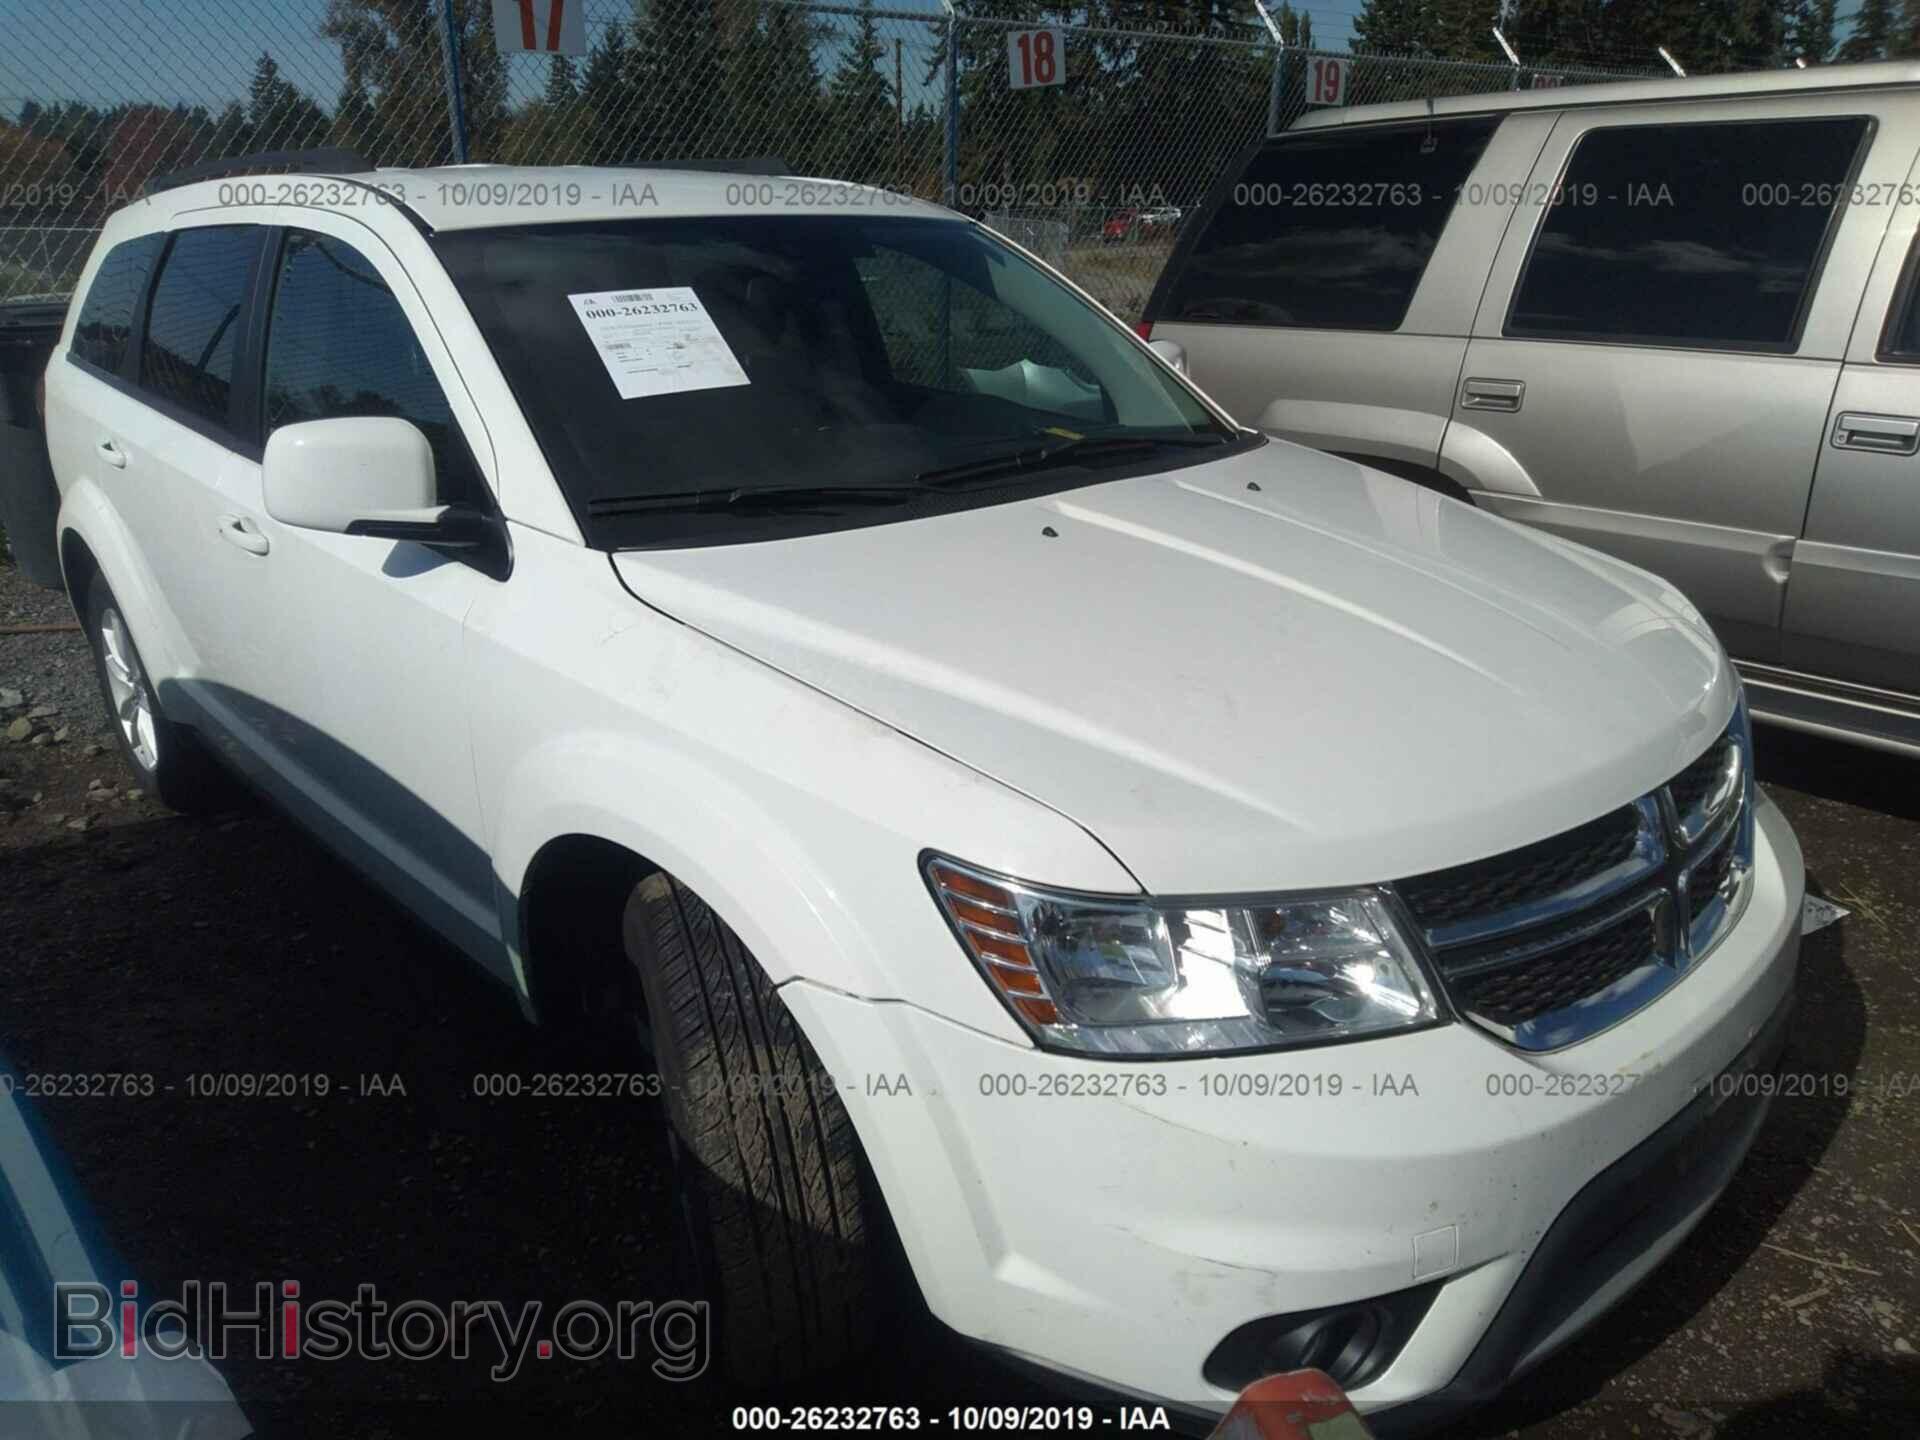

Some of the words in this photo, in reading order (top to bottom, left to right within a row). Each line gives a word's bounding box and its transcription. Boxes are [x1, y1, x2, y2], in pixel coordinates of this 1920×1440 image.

[1017, 31, 1056, 85] 18
[1314, 60, 1340, 102] 19
[586, 302, 698, 319] 000-26232763
